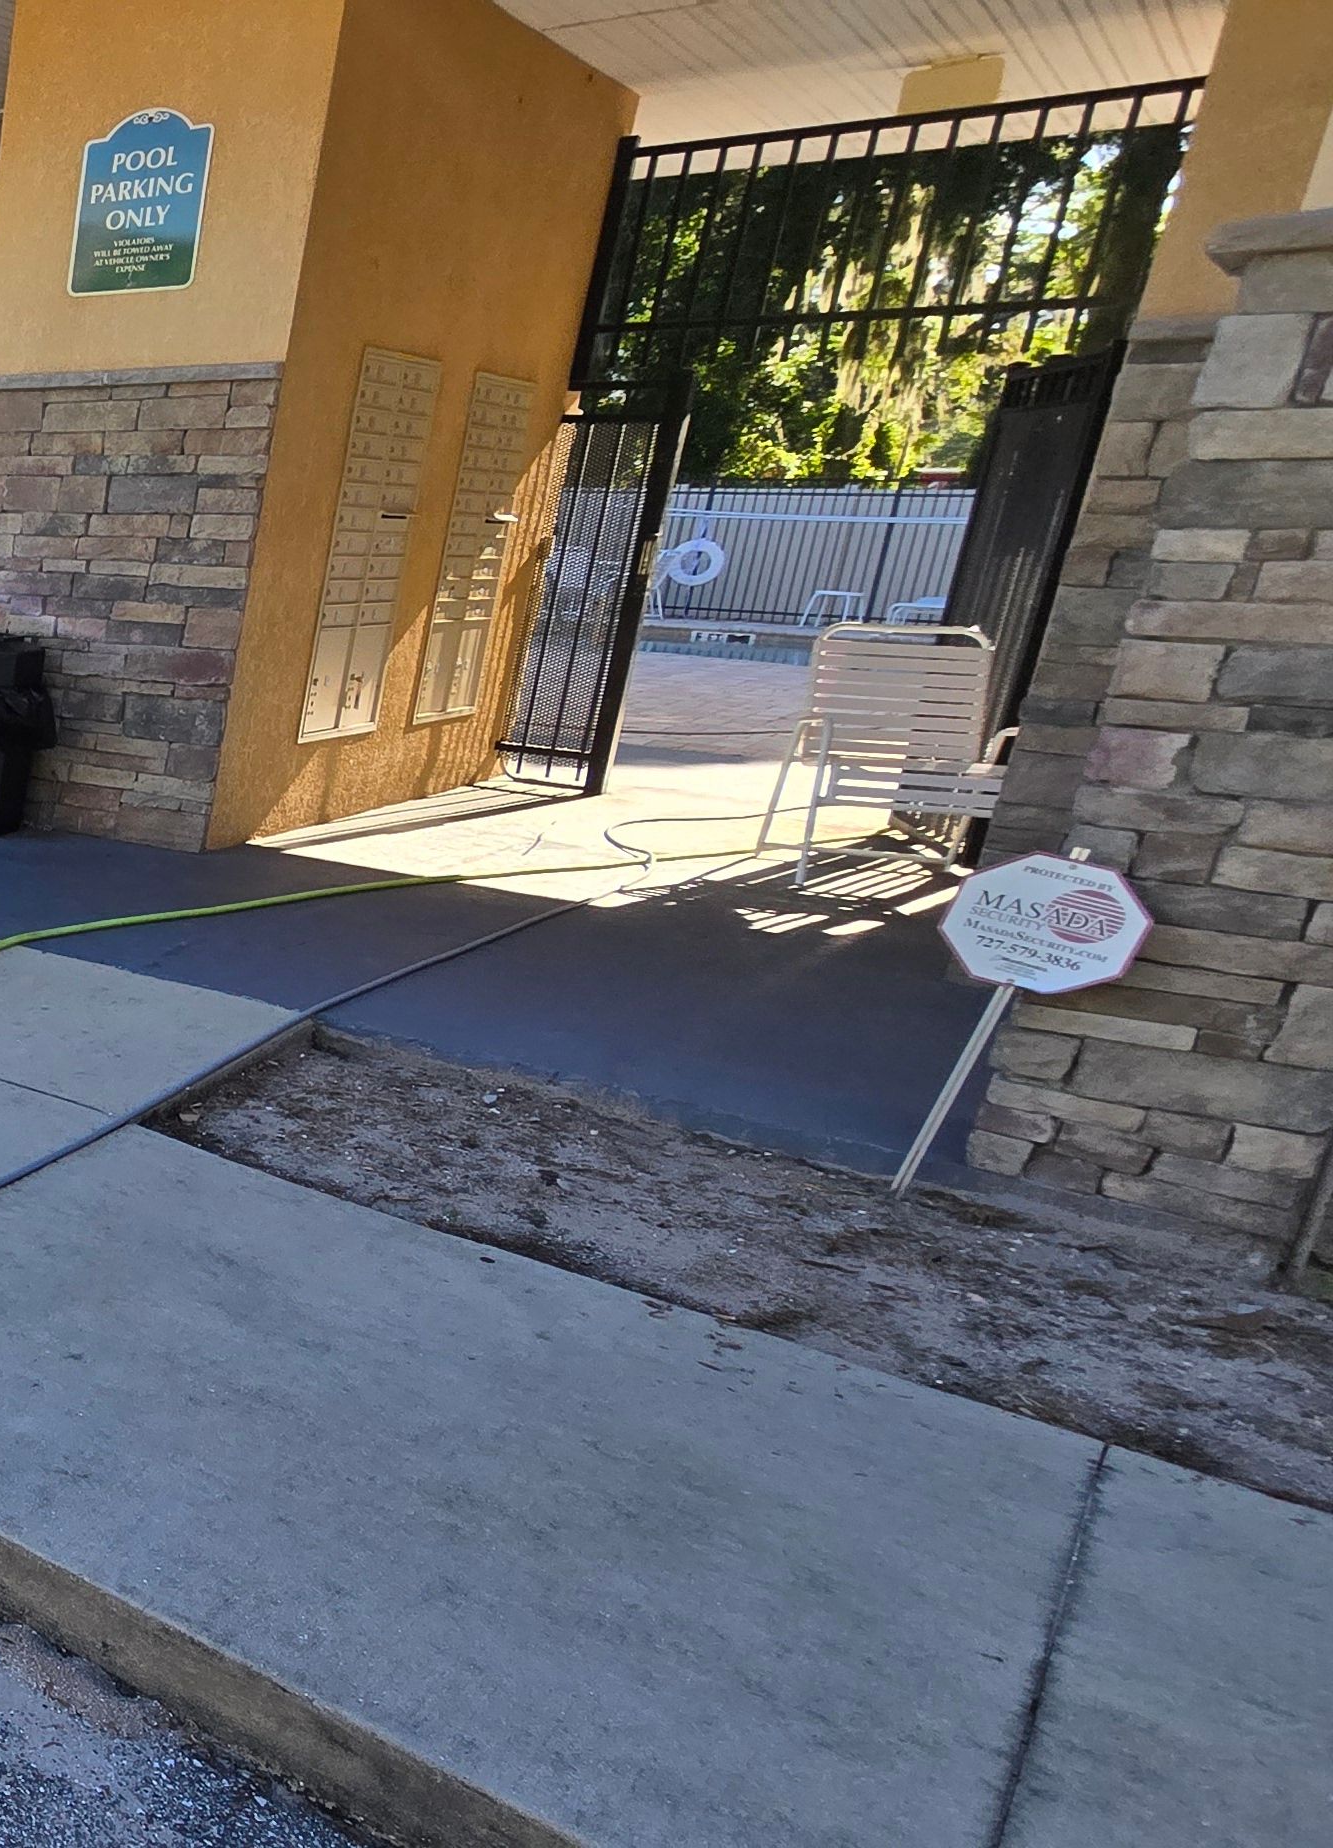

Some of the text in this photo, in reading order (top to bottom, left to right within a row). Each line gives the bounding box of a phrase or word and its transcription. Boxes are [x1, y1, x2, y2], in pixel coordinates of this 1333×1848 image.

[111, 146, 178, 174] POOL
[90, 172, 195, 205] PARKING
[105, 204, 171, 231] ONLY
[93, 243, 174, 258] WILL BE TOWED AWAY
[113, 237, 155, 248] VIOLATORS
[93, 259, 103, 267] AT
[104, 256, 134, 266] VEHICLE
[115, 264, 146, 273] EXPENSE
[1023, 865, 1116, 893] PROTECTED BY
[969, 905, 1046, 931] SECURITY
[974, 889, 1106, 937] MASADA
[975, 934, 1082, 971] 727-579-3836
